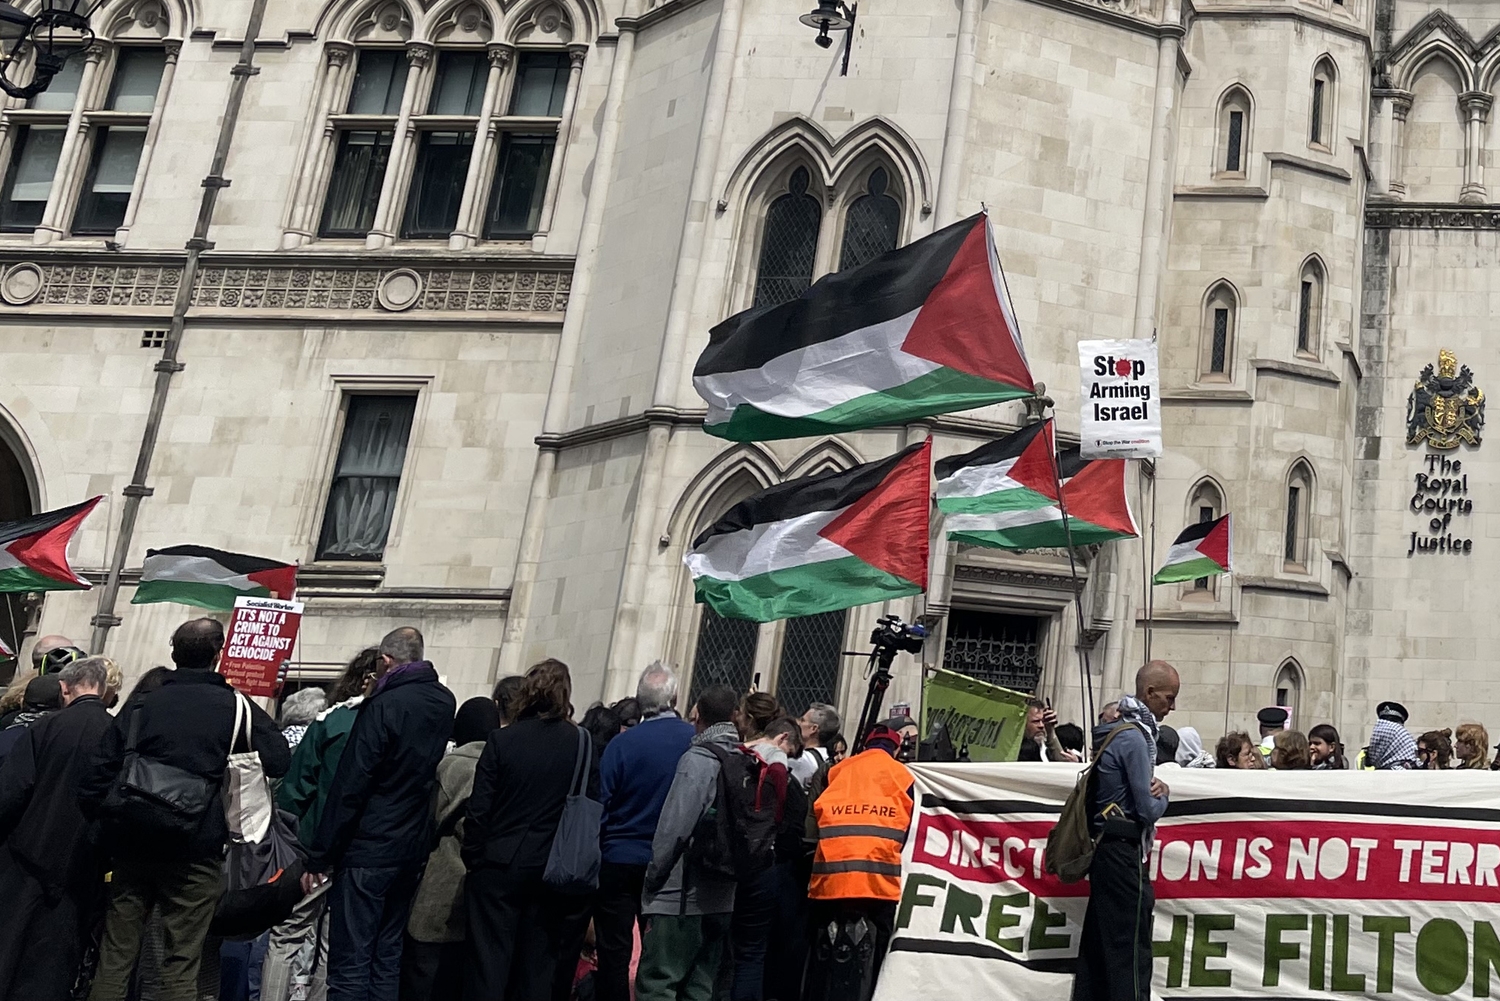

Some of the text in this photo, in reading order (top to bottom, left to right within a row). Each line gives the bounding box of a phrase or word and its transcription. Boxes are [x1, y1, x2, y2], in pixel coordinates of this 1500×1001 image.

[1090, 382, 1150, 401] Arming
[1094, 402, 1148, 421] Israel
[1424, 454, 1461, 475] The
[1414, 473, 1468, 498] Royal
[1410, 493, 1472, 516] Courts
[1430, 513, 1452, 534] of
[1407, 532, 1472, 558] Justice
[237, 609, 287, 625] IT'S NOT A
[234, 621, 281, 636] CRIME TO
[230, 633, 292, 650] ACT AGAINST
[227, 646, 277, 661] GENOCIDE
[832, 804, 896, 818] WELFARE
[923, 826, 1048, 879] DIRECT
[1232, 837, 1273, 881] IS
[1285, 837, 1378, 882] NOT
[898, 873, 1071, 952] FREE
[1150, 914, 1235, 988] HE
